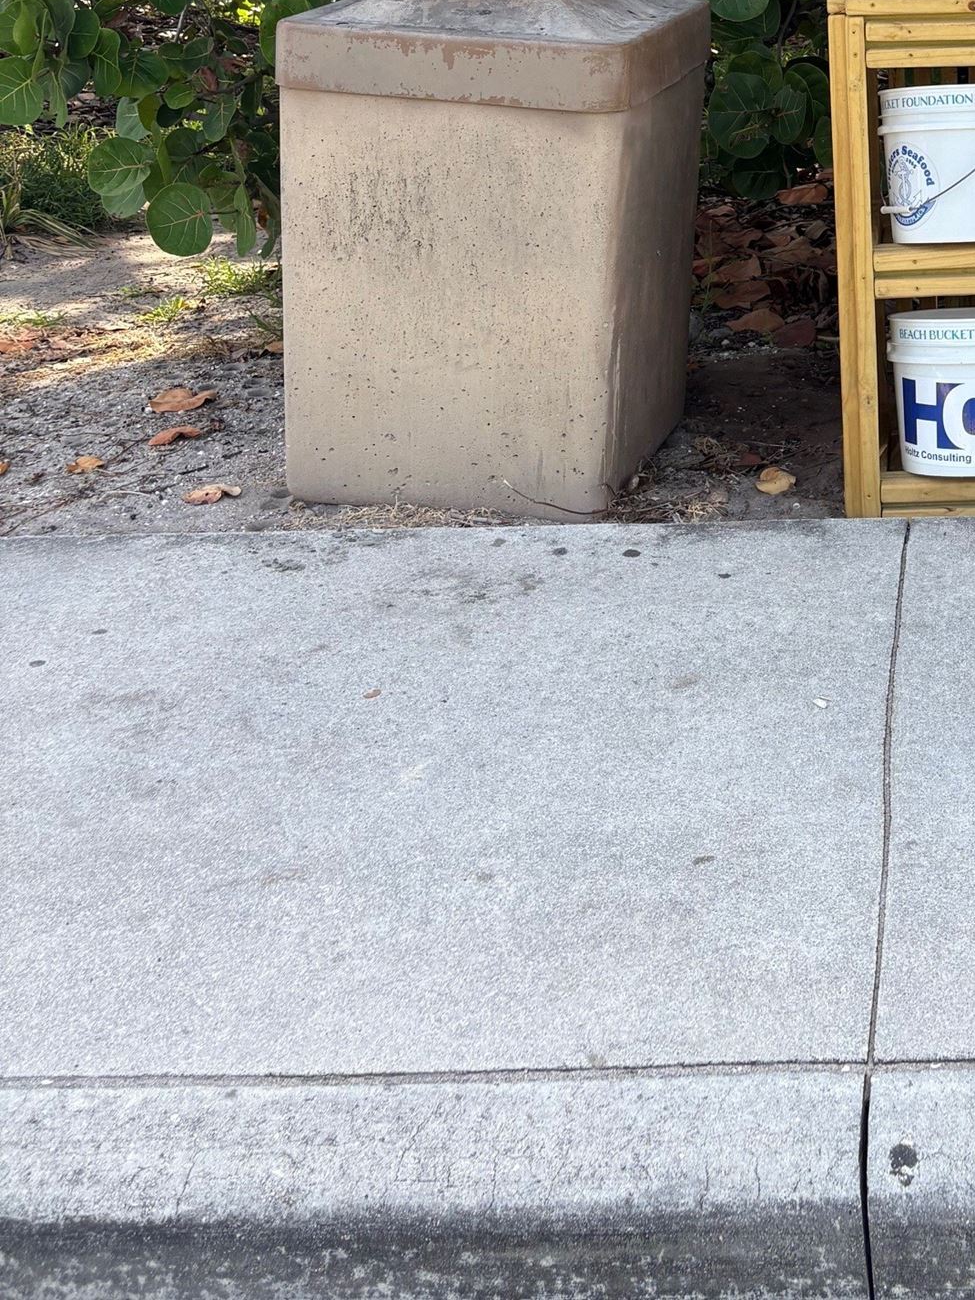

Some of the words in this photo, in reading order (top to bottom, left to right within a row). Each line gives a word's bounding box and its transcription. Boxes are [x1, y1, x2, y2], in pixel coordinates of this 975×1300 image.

[902, 93, 974, 108] FOUNDATION
[901, 145, 935, 186] Seafood
[899, 328, 927, 340] BEACH
[929, 329, 975, 340] BUCKET
[920, 450, 972, 464] Consulting
